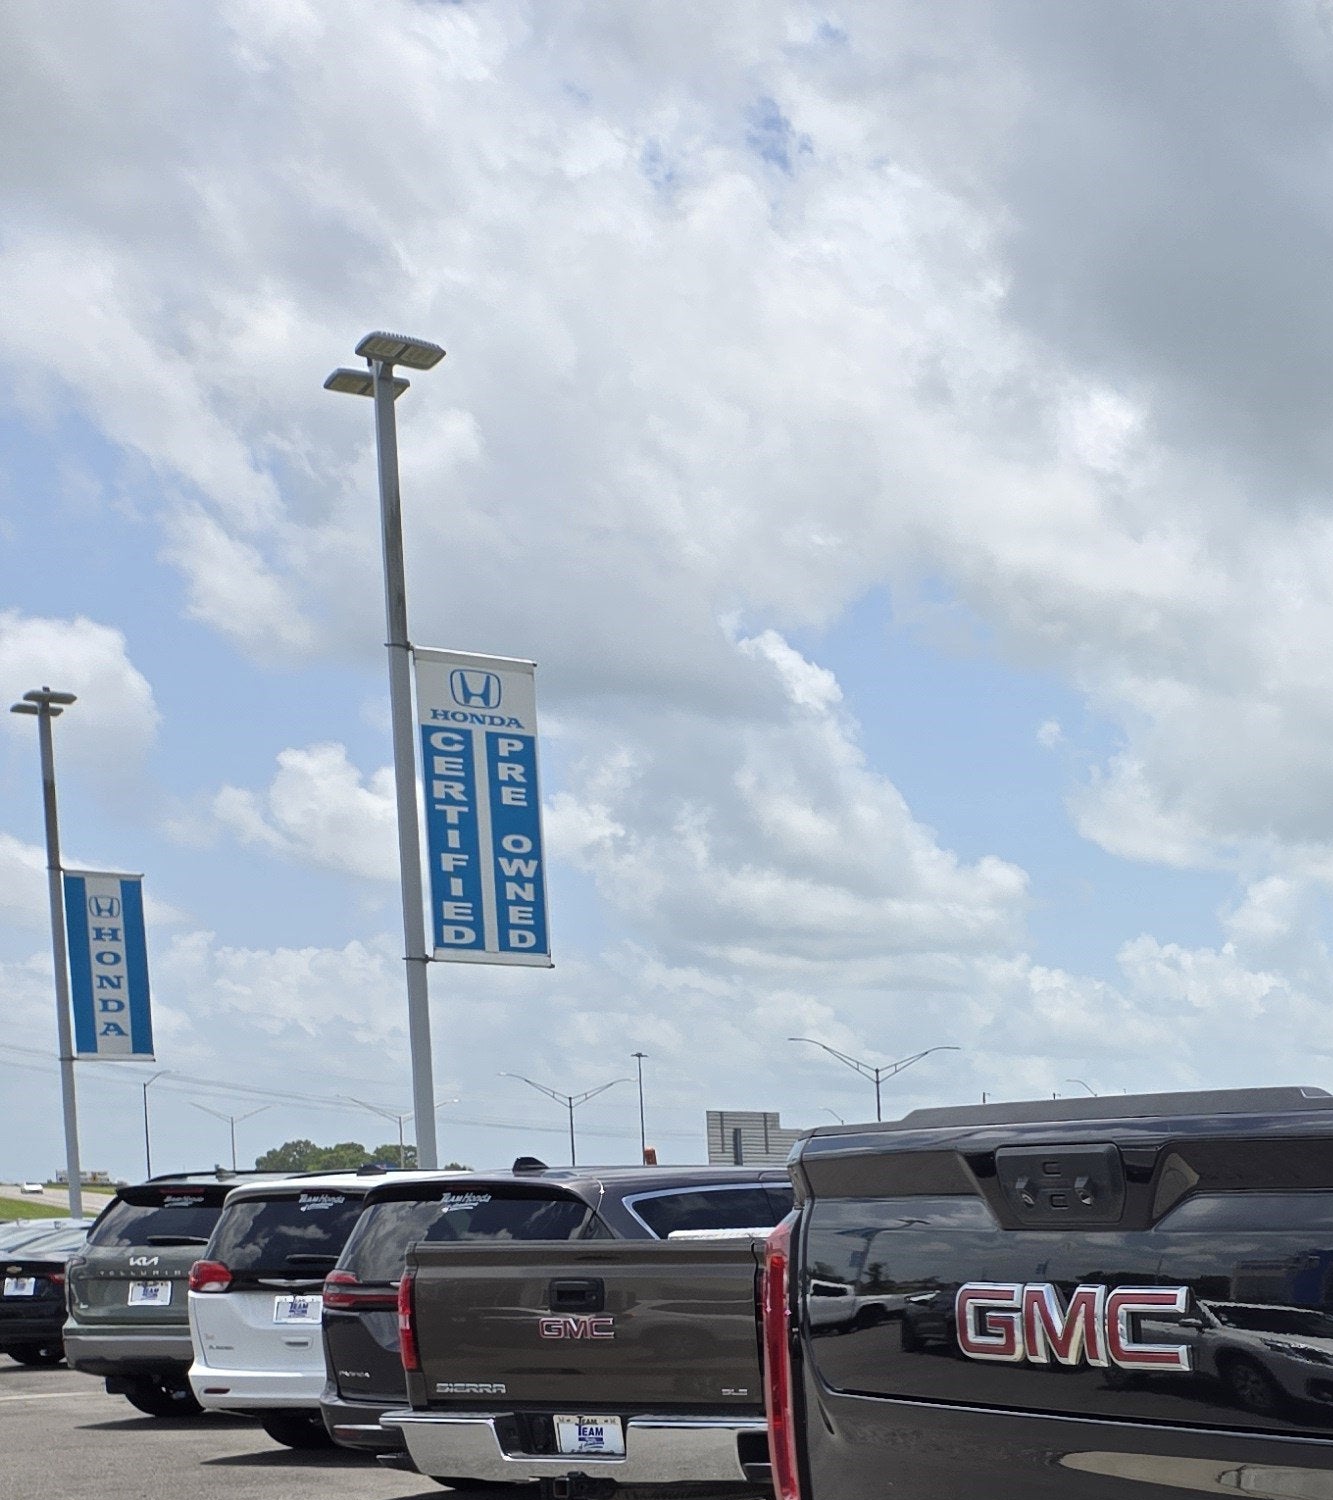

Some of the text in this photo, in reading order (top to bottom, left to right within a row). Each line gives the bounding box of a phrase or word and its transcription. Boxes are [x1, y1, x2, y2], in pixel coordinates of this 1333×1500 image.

[430, 708, 525, 730] HONDA
[430, 731, 476, 946] CERTIFIED
[497, 737, 538, 949] PRE OWNED
[92, 927, 129, 1037] HONDA
[540, 1317, 614, 1339] GMC
[955, 1282, 1194, 1372] GMC
[436, 1382, 506, 1394] SIERRA
[575, 1423, 604, 1437] TEAM
